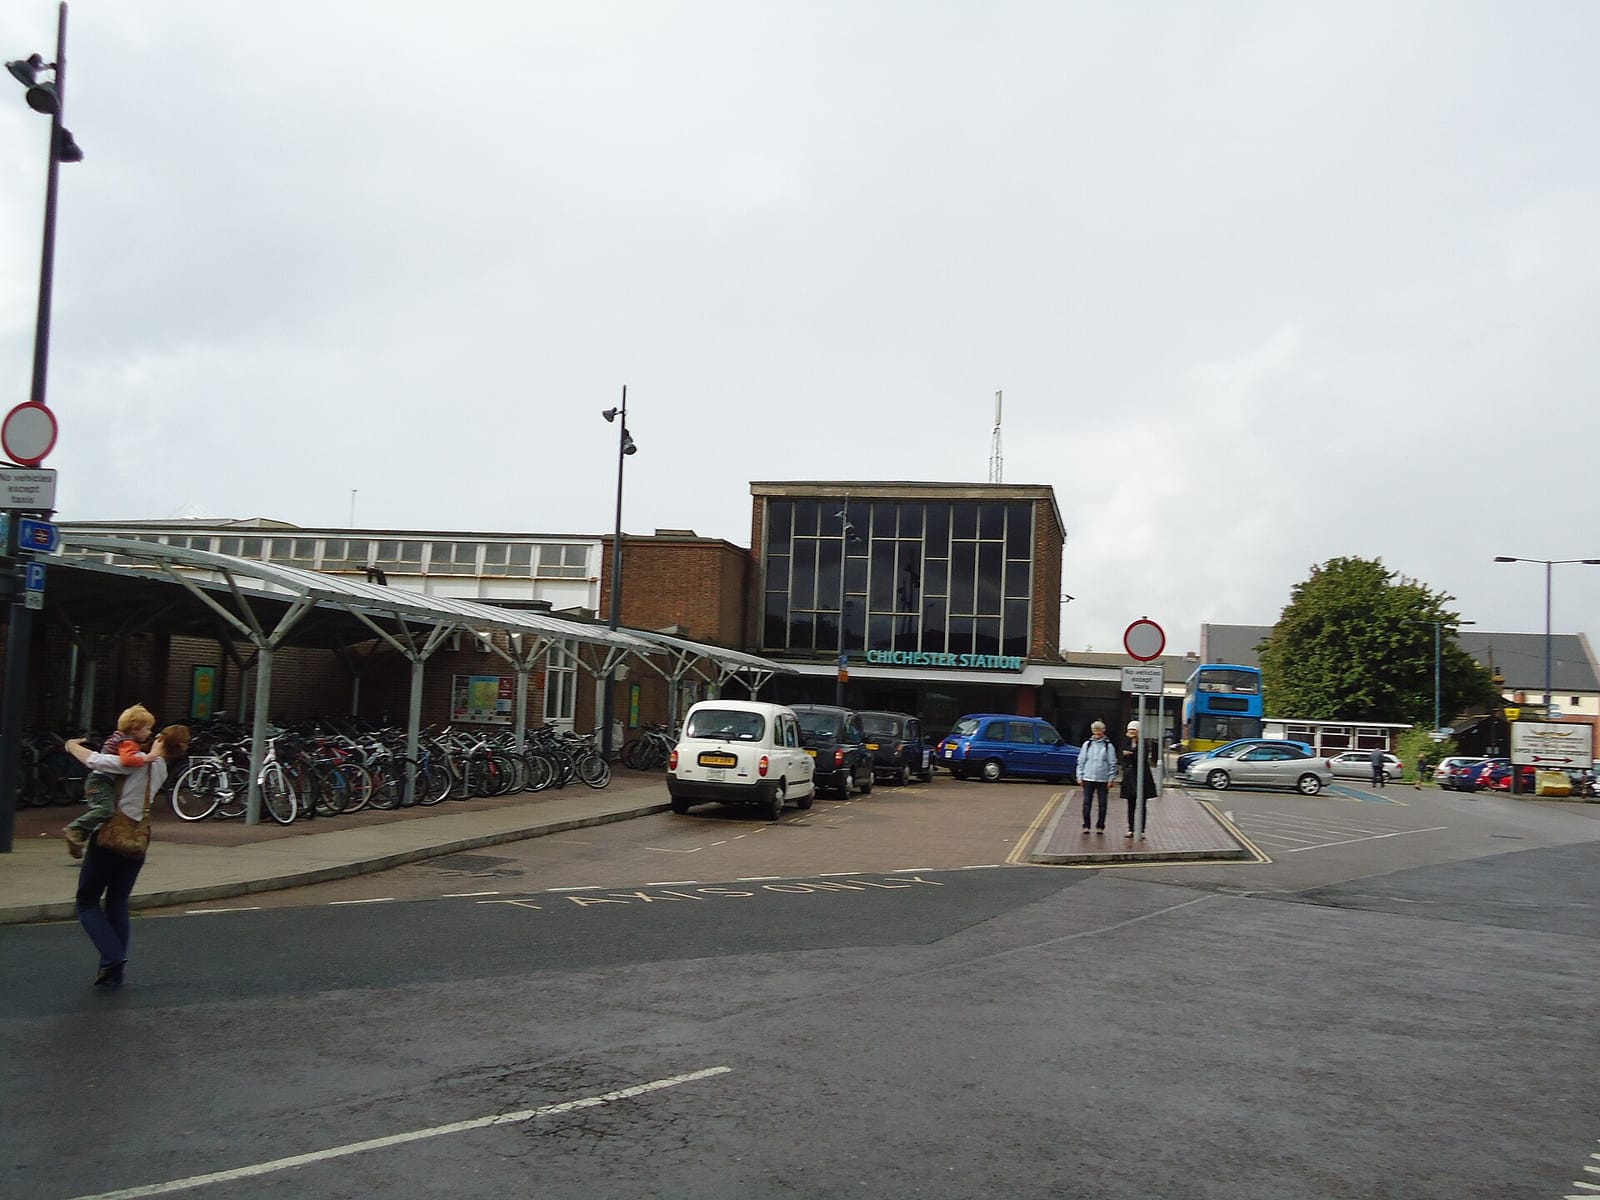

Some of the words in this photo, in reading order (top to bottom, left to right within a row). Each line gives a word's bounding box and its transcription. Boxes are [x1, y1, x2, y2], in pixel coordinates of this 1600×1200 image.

[31, 566, 44, 588] P
[867, 650, 957, 666] CHICHESTER
[959, 654, 1021, 669] STATION
[762, 877, 944, 893] ONLY
